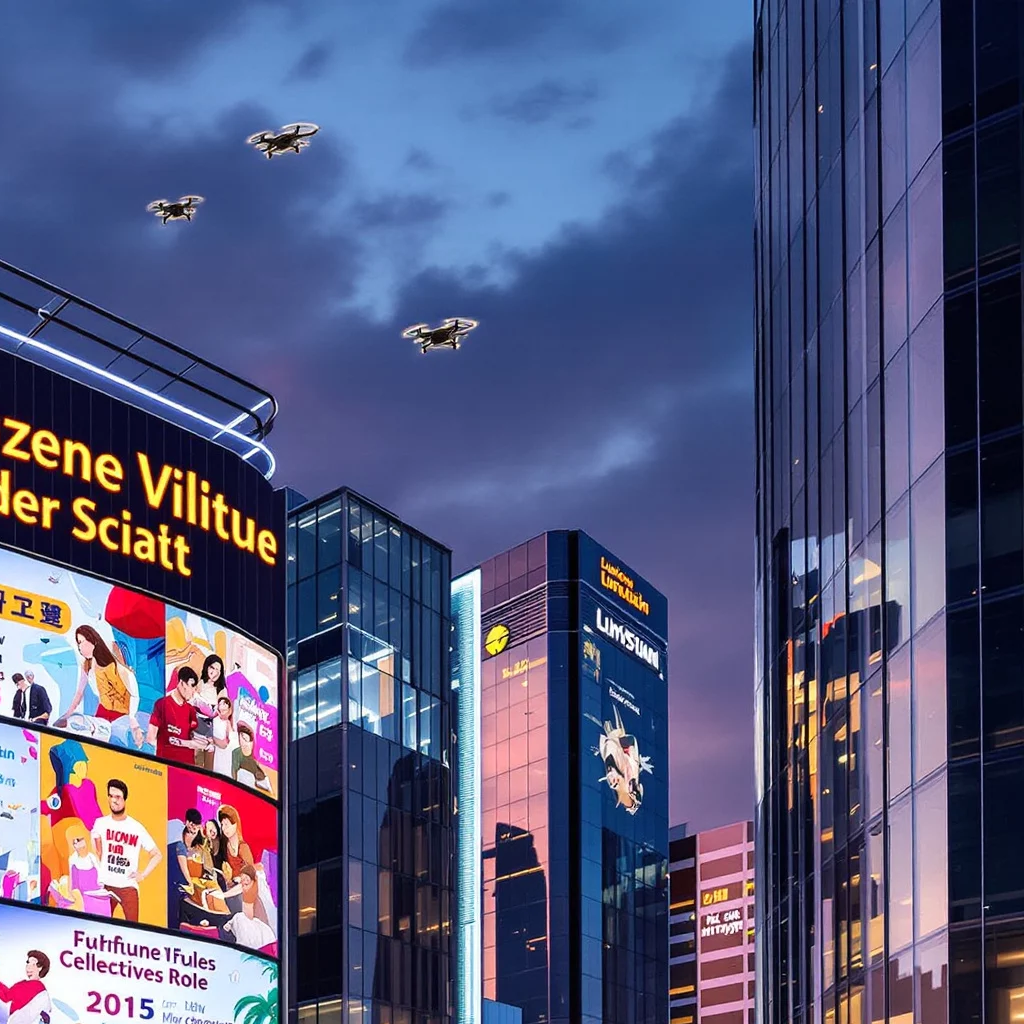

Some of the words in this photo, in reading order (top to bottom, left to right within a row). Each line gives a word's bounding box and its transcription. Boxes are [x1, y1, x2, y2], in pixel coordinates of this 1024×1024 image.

[136, 451, 277, 566] Vilitue
[72, 497, 191, 577] Sciatt
[87, 990, 154, 1020] 2015
[169, 968, 208, 990] Role
